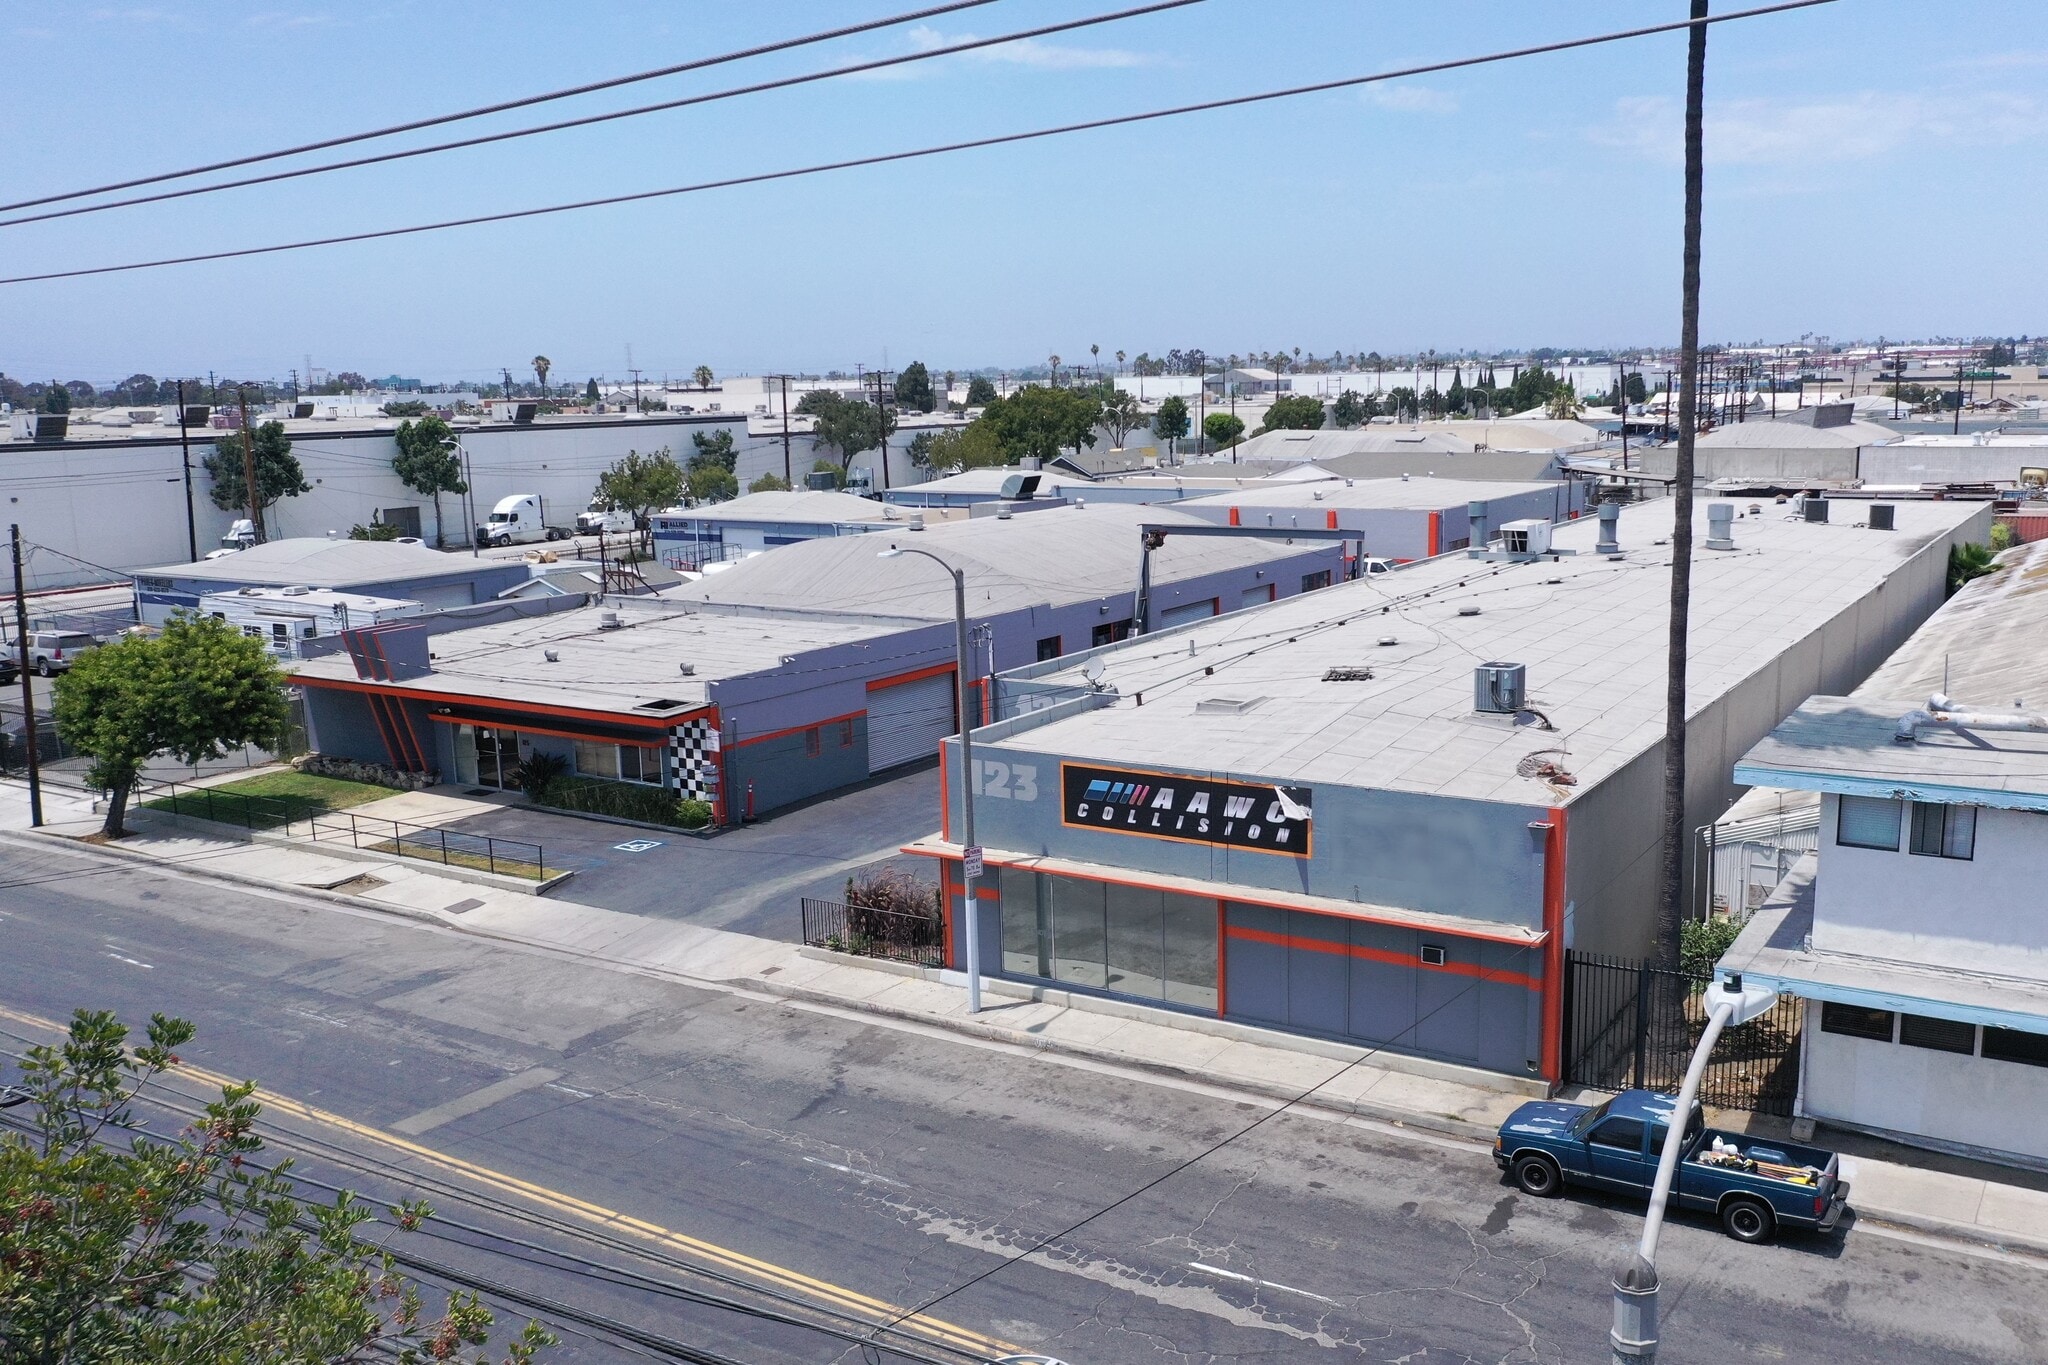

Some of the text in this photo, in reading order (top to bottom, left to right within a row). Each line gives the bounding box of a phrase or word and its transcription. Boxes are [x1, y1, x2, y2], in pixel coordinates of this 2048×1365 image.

[971, 758, 1038, 802] 123
[1077, 803, 1290, 843] COLLISION
[966, 857, 981, 865] MONDAY
